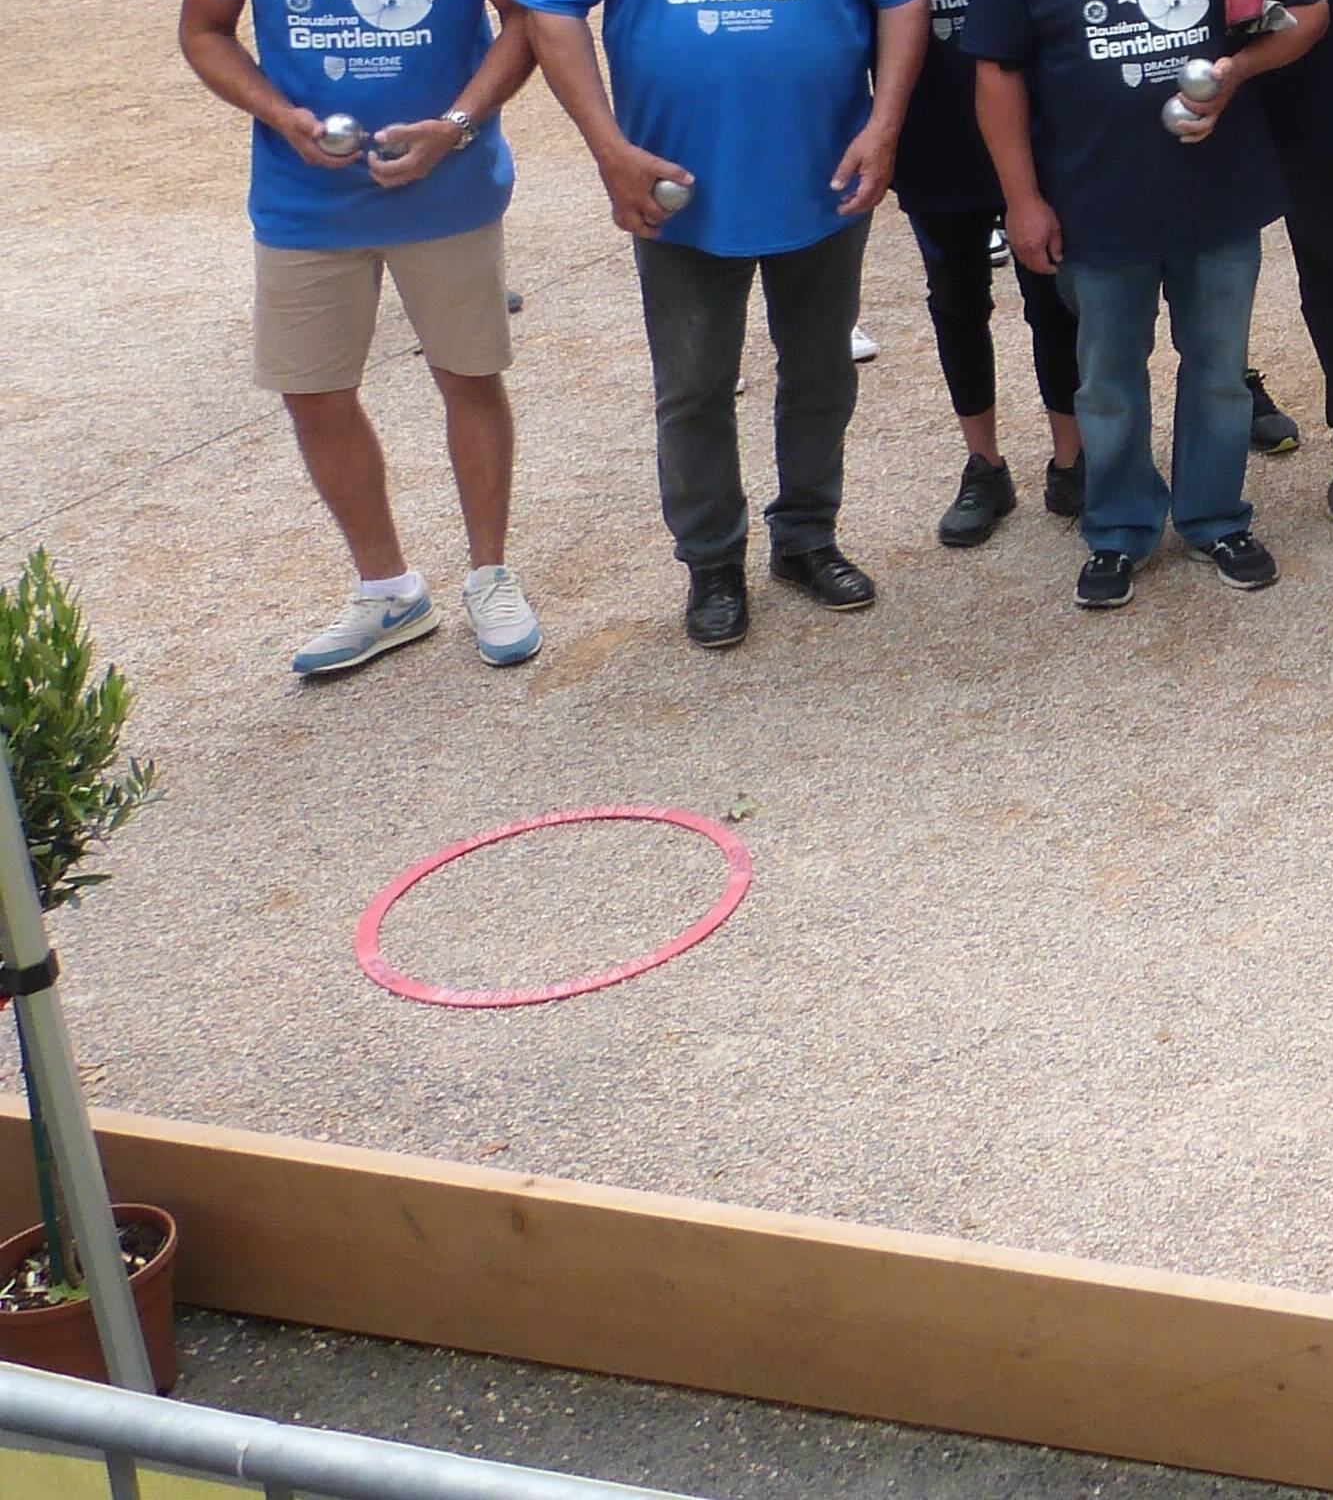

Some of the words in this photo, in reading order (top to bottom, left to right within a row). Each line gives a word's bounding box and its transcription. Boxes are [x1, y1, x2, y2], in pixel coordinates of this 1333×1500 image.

[287, 13, 359, 27] Douzième
[289, 27, 433, 50] Gentlemen
[1088, 25, 1211, 61] Gentlemen
